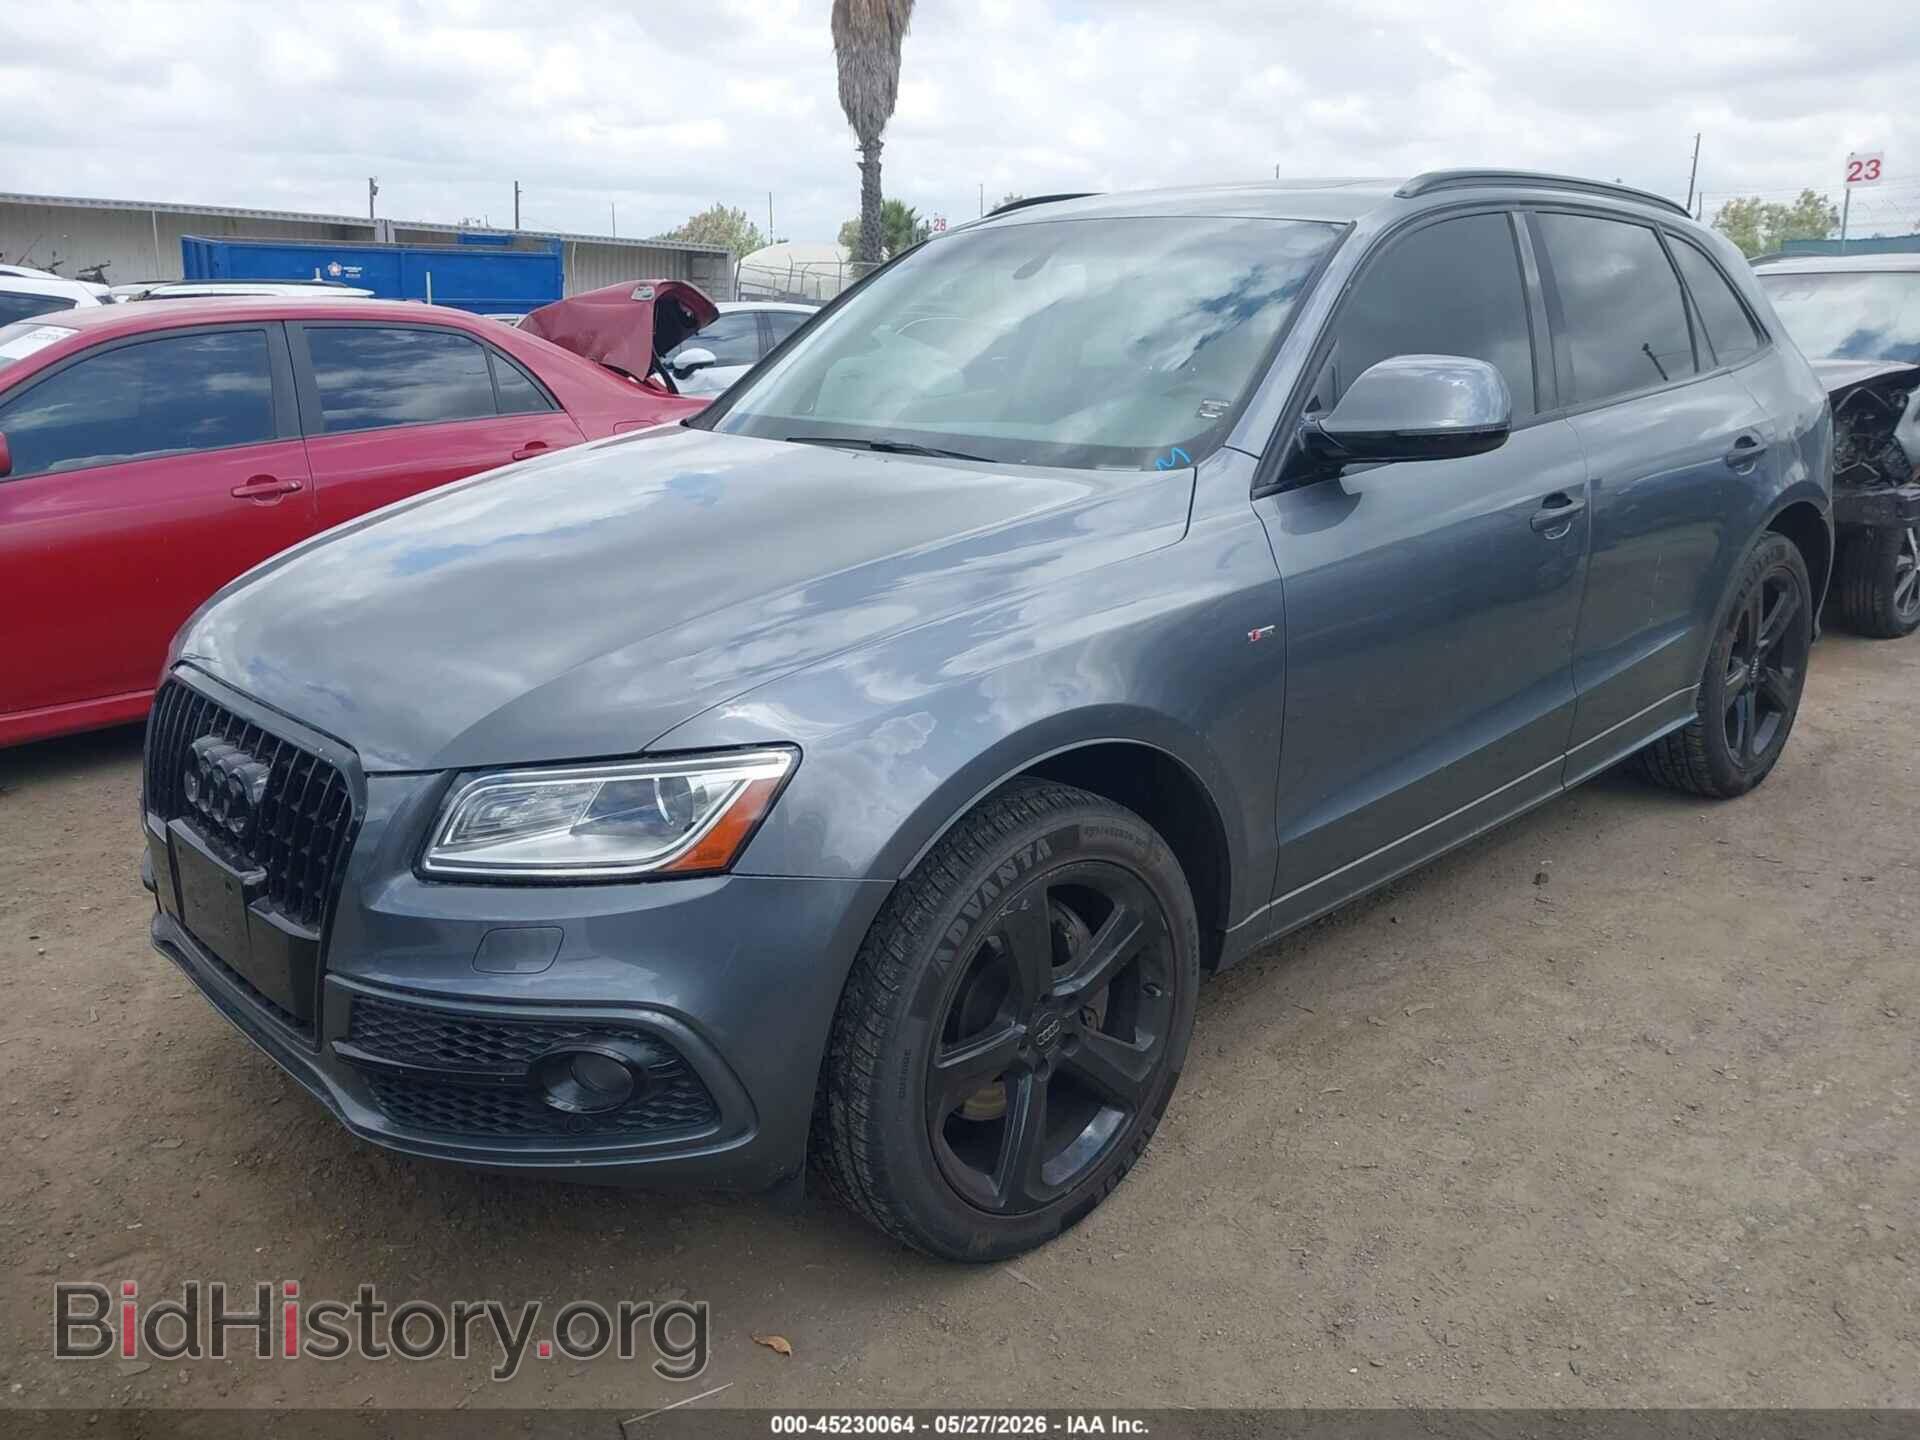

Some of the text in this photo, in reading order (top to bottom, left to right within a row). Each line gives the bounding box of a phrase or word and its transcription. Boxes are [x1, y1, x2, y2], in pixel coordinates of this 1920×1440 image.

[1846, 159, 1881, 182] 23
[933, 217, 946, 231] 28
[932, 836, 1054, 976] ADVANTA
